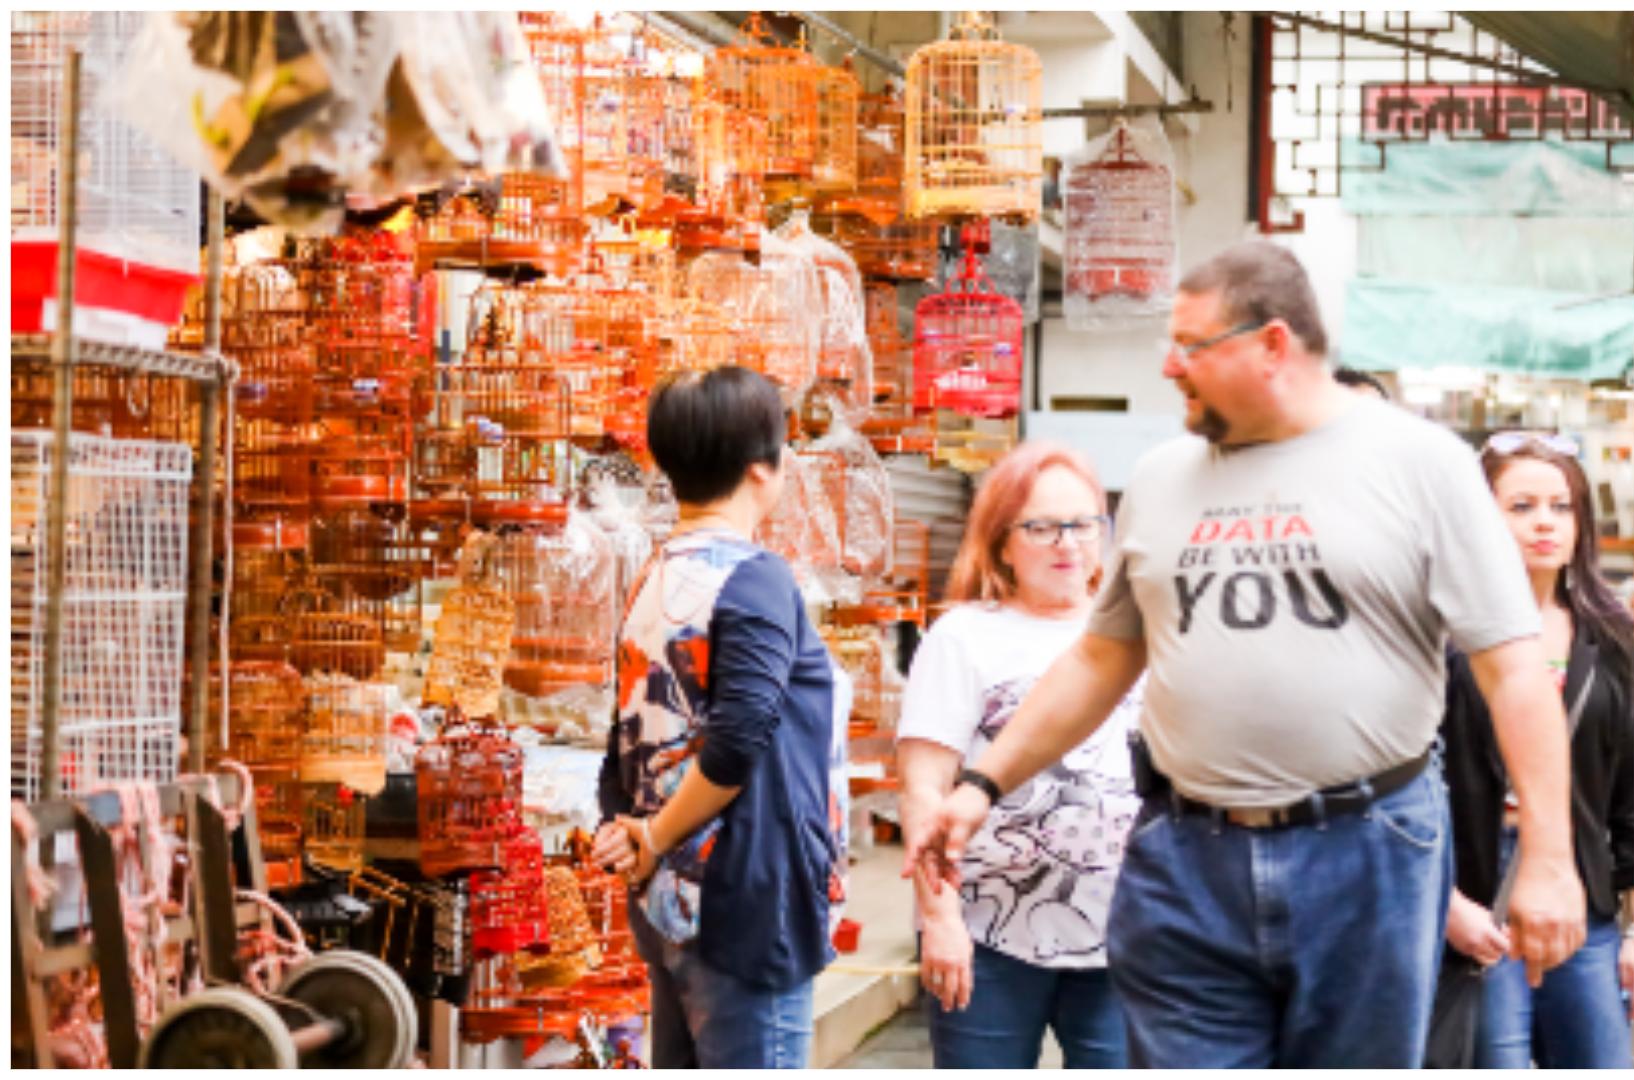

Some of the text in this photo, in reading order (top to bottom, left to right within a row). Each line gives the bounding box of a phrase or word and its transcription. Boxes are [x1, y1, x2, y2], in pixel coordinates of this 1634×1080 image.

[1189, 514, 1313, 545] DATA
[1178, 543, 1321, 569] BE WITH
[1173, 567, 1350, 635] YOU
